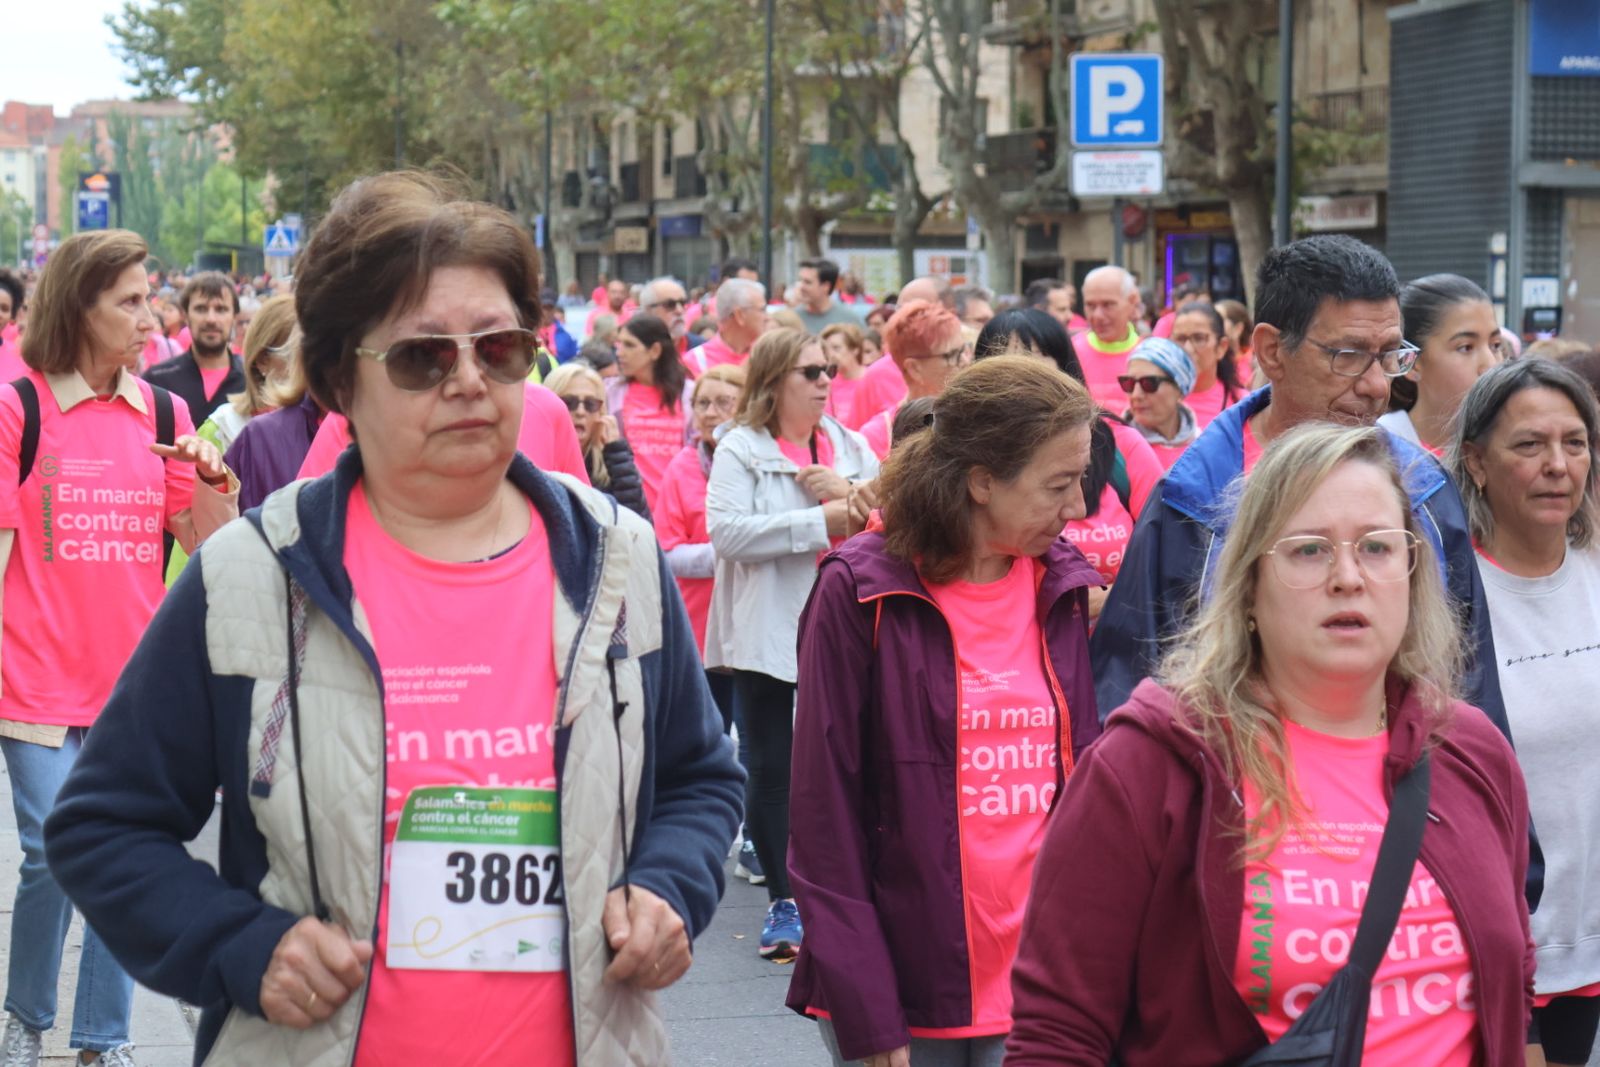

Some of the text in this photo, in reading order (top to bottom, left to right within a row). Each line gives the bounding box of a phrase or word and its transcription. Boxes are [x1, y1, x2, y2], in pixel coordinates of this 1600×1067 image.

[1089, 65, 1145, 136] P
[57, 483, 164, 507] En marcha
[57, 511, 160, 533] contra el
[1062, 523, 1128, 543] archa
[58, 533, 159, 563] cáncer
[437, 662, 492, 677] española
[412, 679, 424, 690] el
[411, 811, 520, 827] contra el cáncer
[445, 850, 561, 905] 3862
[1282, 869, 1339, 906] En
[1285, 921, 1465, 965] cotra
